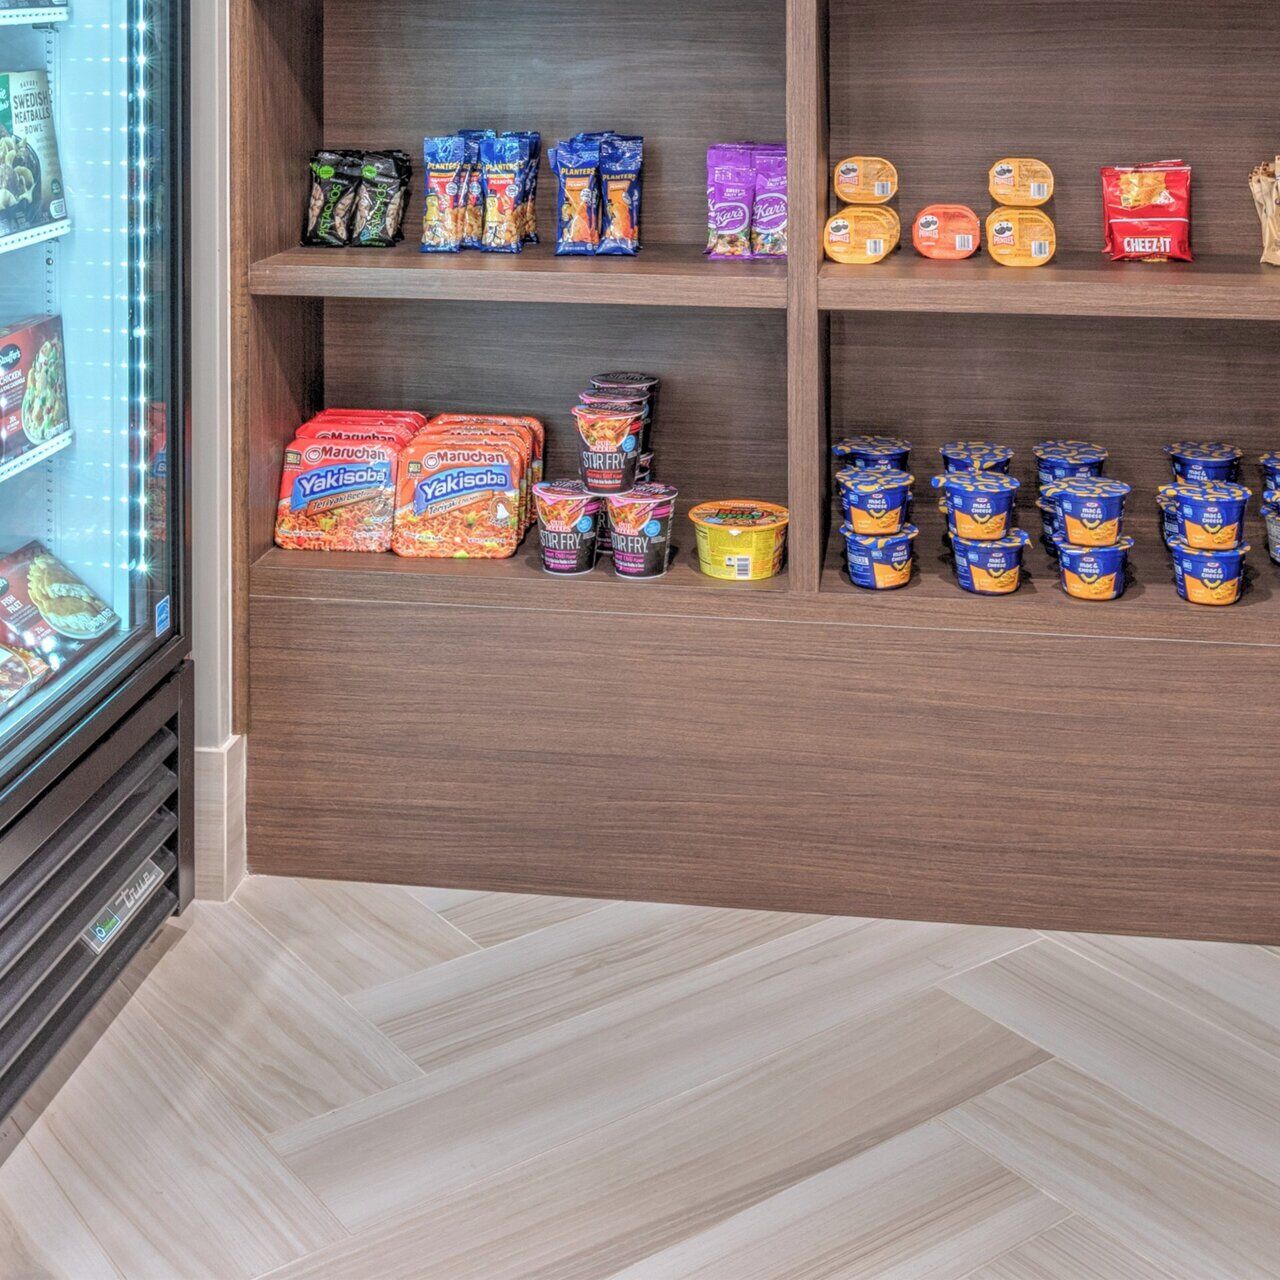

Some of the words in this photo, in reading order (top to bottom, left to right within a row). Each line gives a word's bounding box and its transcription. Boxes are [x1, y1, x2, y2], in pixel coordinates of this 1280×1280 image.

[12, 89, 48, 109] SWEDISH
[14, 107, 51, 125] MEATBALLS
[485, 162, 519, 171] PLANTERS
[561, 167, 596, 176] PLANTERS
[602, 173, 637, 181] PLANTERS
[321, 445, 386, 461] Maruchan
[438, 449, 506, 464] Maruchan
[605, 452, 626, 470] FRY
[299, 469, 387, 496] Yakisoba
[422, 473, 507, 501] Yakisoba
[312, 494, 346, 511] Teriyaki
[560, 532, 582, 550] FRY
[629, 535, 650, 554] FRY
[115, 872, 156, 908] true
